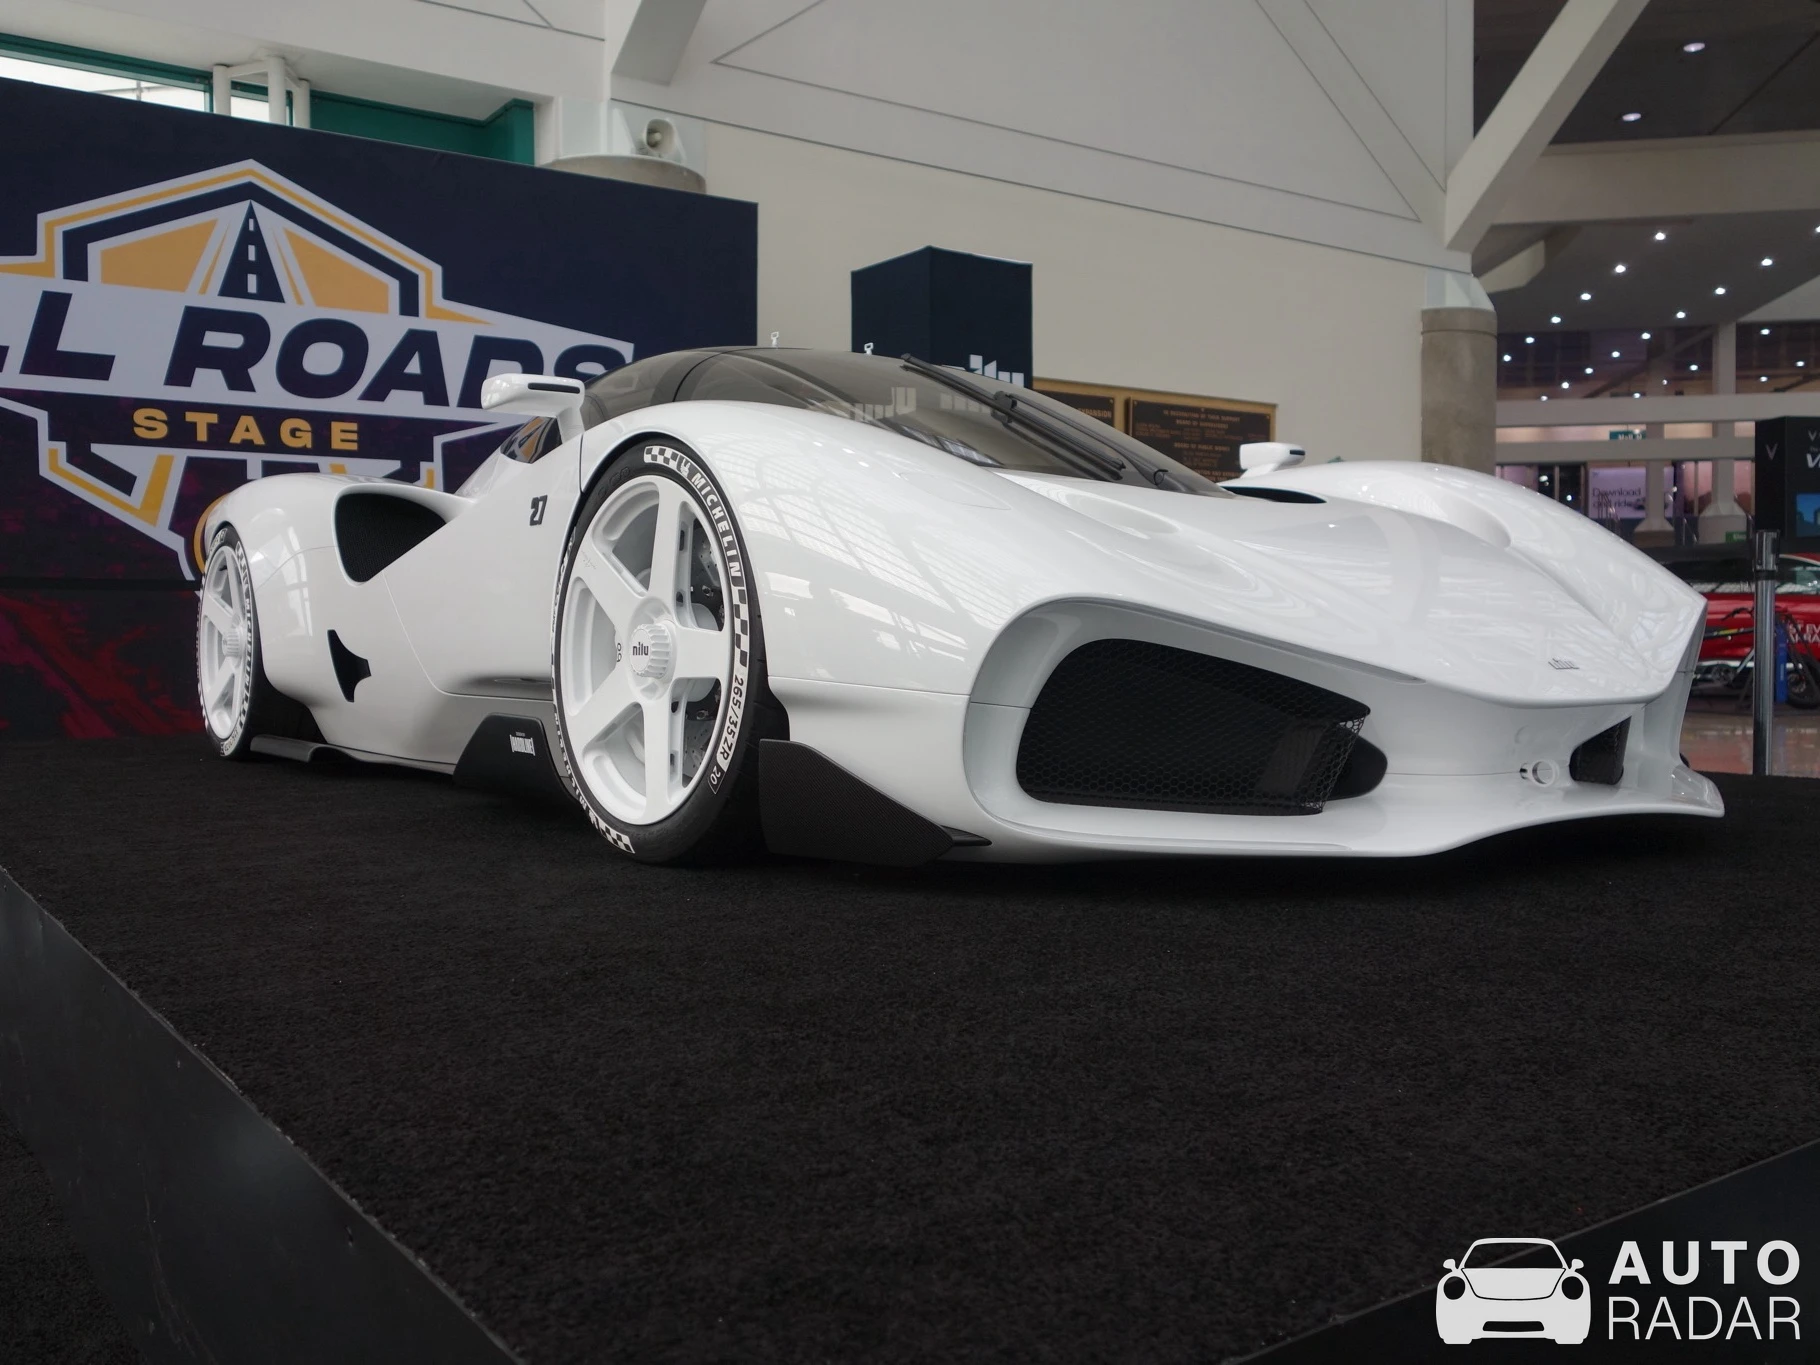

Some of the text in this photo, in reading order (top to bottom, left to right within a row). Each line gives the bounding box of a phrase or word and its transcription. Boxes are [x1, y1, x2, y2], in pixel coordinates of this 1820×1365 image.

[0, 290, 116, 382] L
[133, 407, 361, 452] STAGE
[529, 494, 549, 526] 27
[1592, 487, 1641, 497] Download
[691, 472, 743, 578] MICHELIN
[632, 641, 649, 656] nilu
[709, 674, 745, 786] 265/35ZR 20
